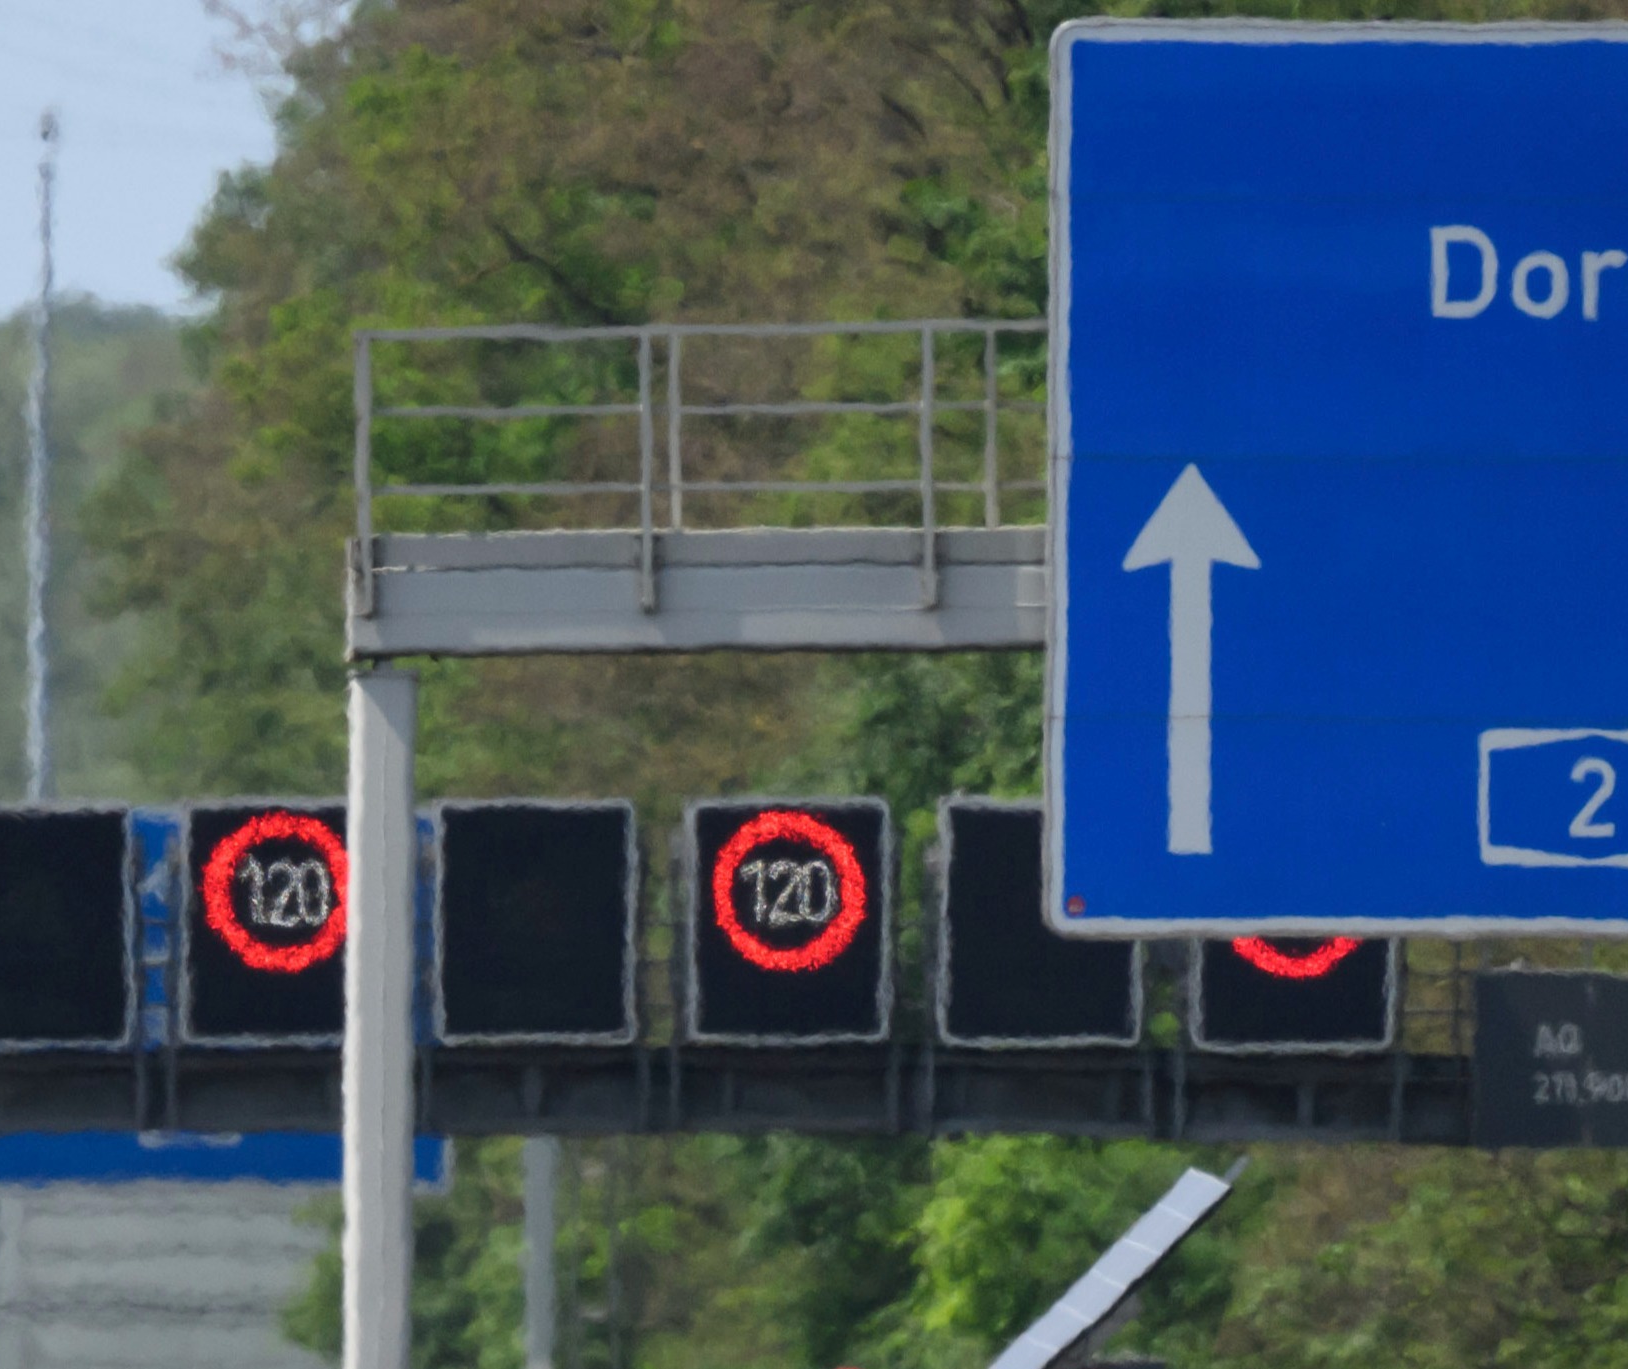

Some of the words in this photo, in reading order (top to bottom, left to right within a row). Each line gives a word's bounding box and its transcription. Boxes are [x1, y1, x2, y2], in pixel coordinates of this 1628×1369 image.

[1568, 757, 1618, 839] 2
[240, 852, 329, 928] 120
[739, 860, 838, 927] 120
